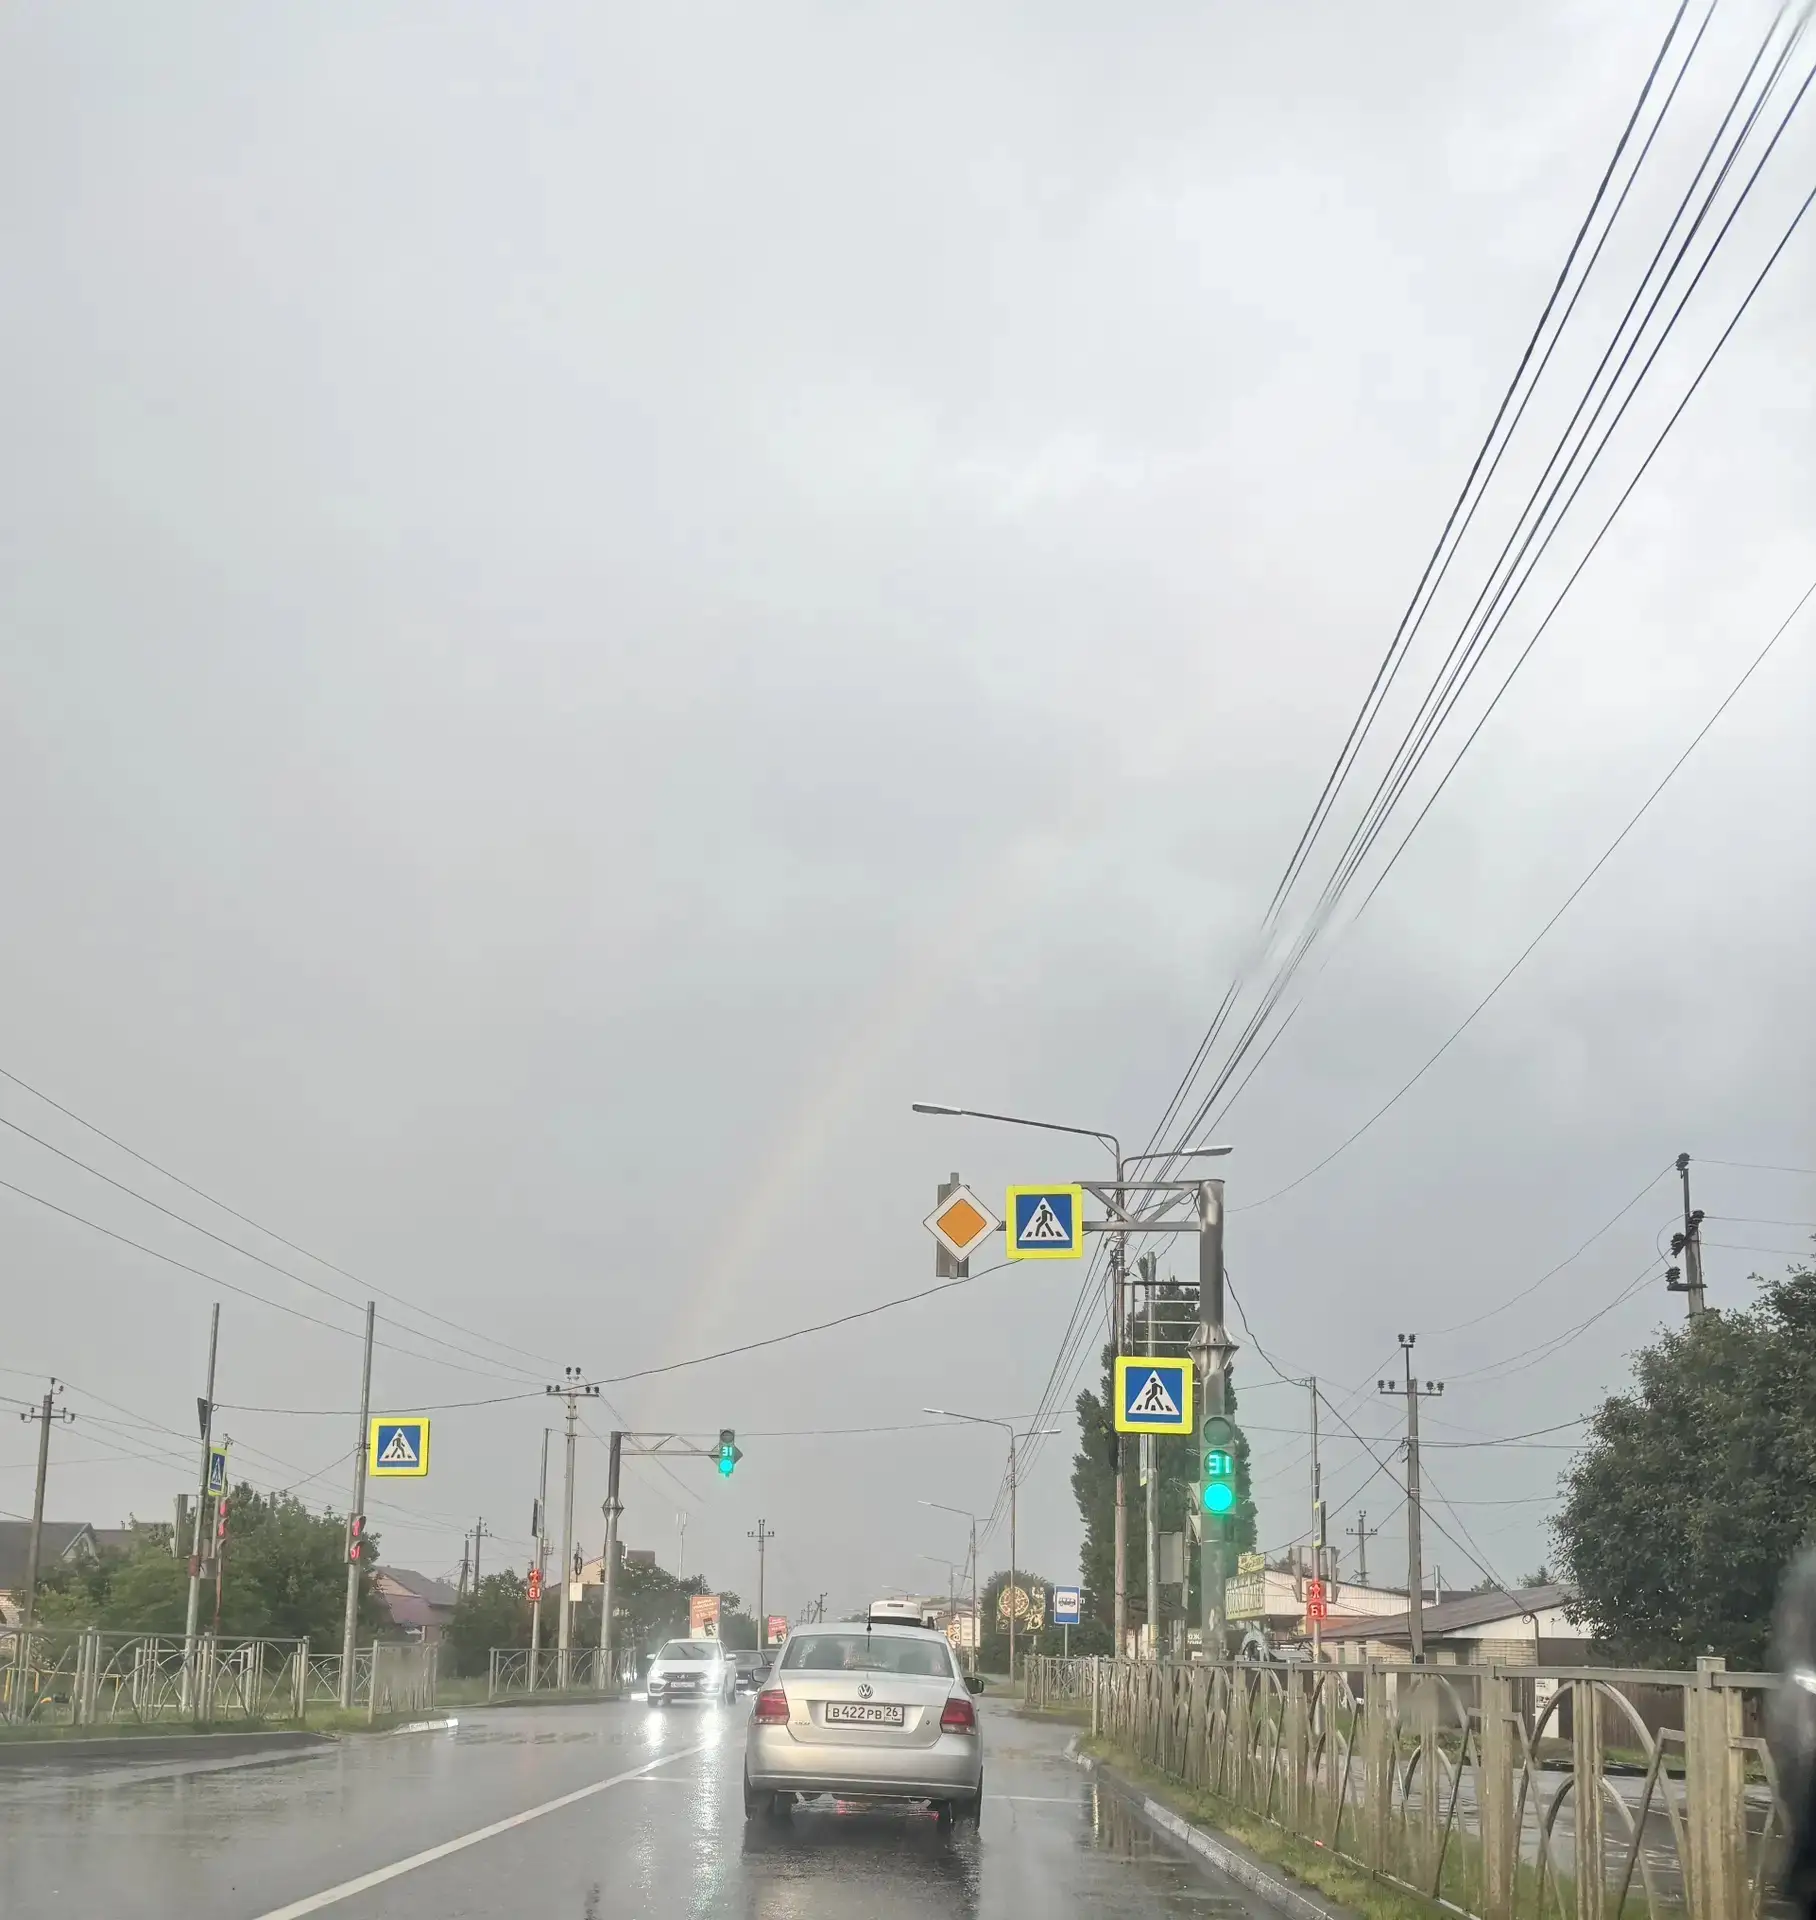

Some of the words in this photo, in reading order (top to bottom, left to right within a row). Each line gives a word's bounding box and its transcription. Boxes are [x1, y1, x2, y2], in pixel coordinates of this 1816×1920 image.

[722, 1446, 733, 1457] 31
[1208, 1454, 1231, 1475] 31
[529, 1587, 541, 1598] 61
[1311, 1603, 1325, 1616] 61
[885, 1706, 899, 1717] 26
